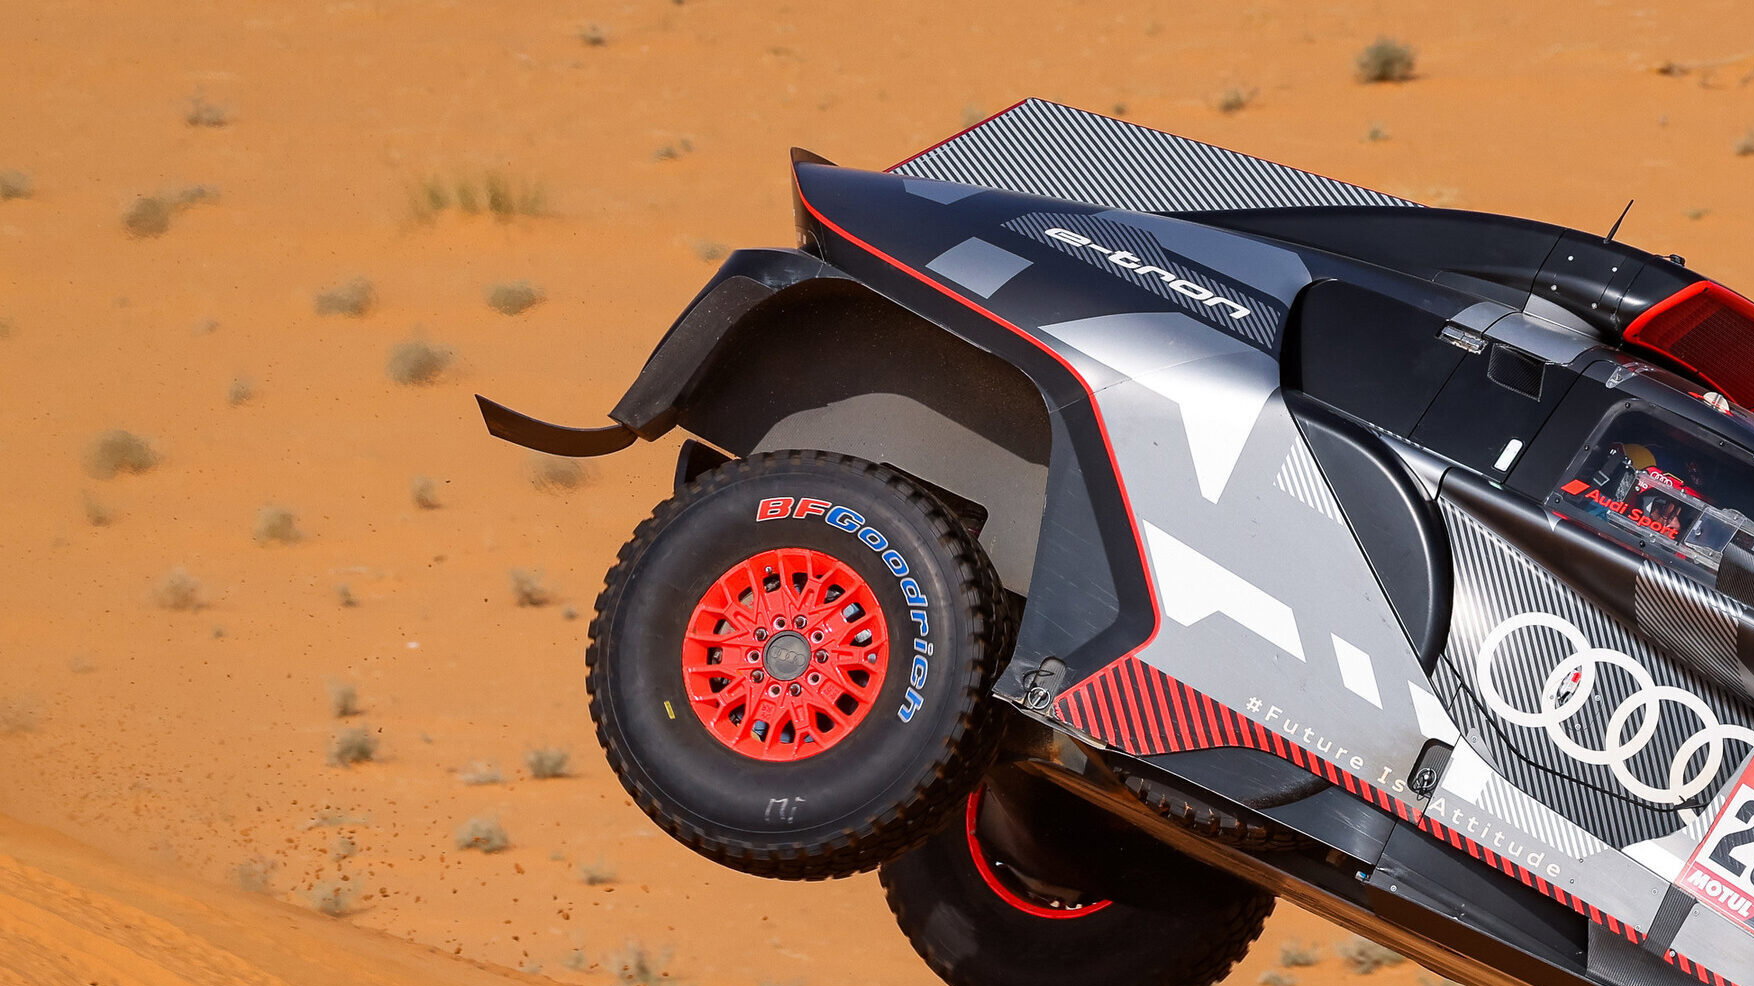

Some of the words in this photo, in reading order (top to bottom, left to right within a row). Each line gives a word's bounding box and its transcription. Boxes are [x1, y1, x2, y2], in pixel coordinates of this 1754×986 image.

[1044, 225, 1251, 320] e-tron
[1585, 488, 1627, 513] Audi
[1628, 508, 1681, 540] Sport
[755, 496, 930, 725] BFGoodrich
[1245, 695, 1366, 772] #Future
[1375, 765, 1407, 794] Is
[1426, 797, 1564, 880] Attitude
[1687, 871, 1754, 918] MOTUL
